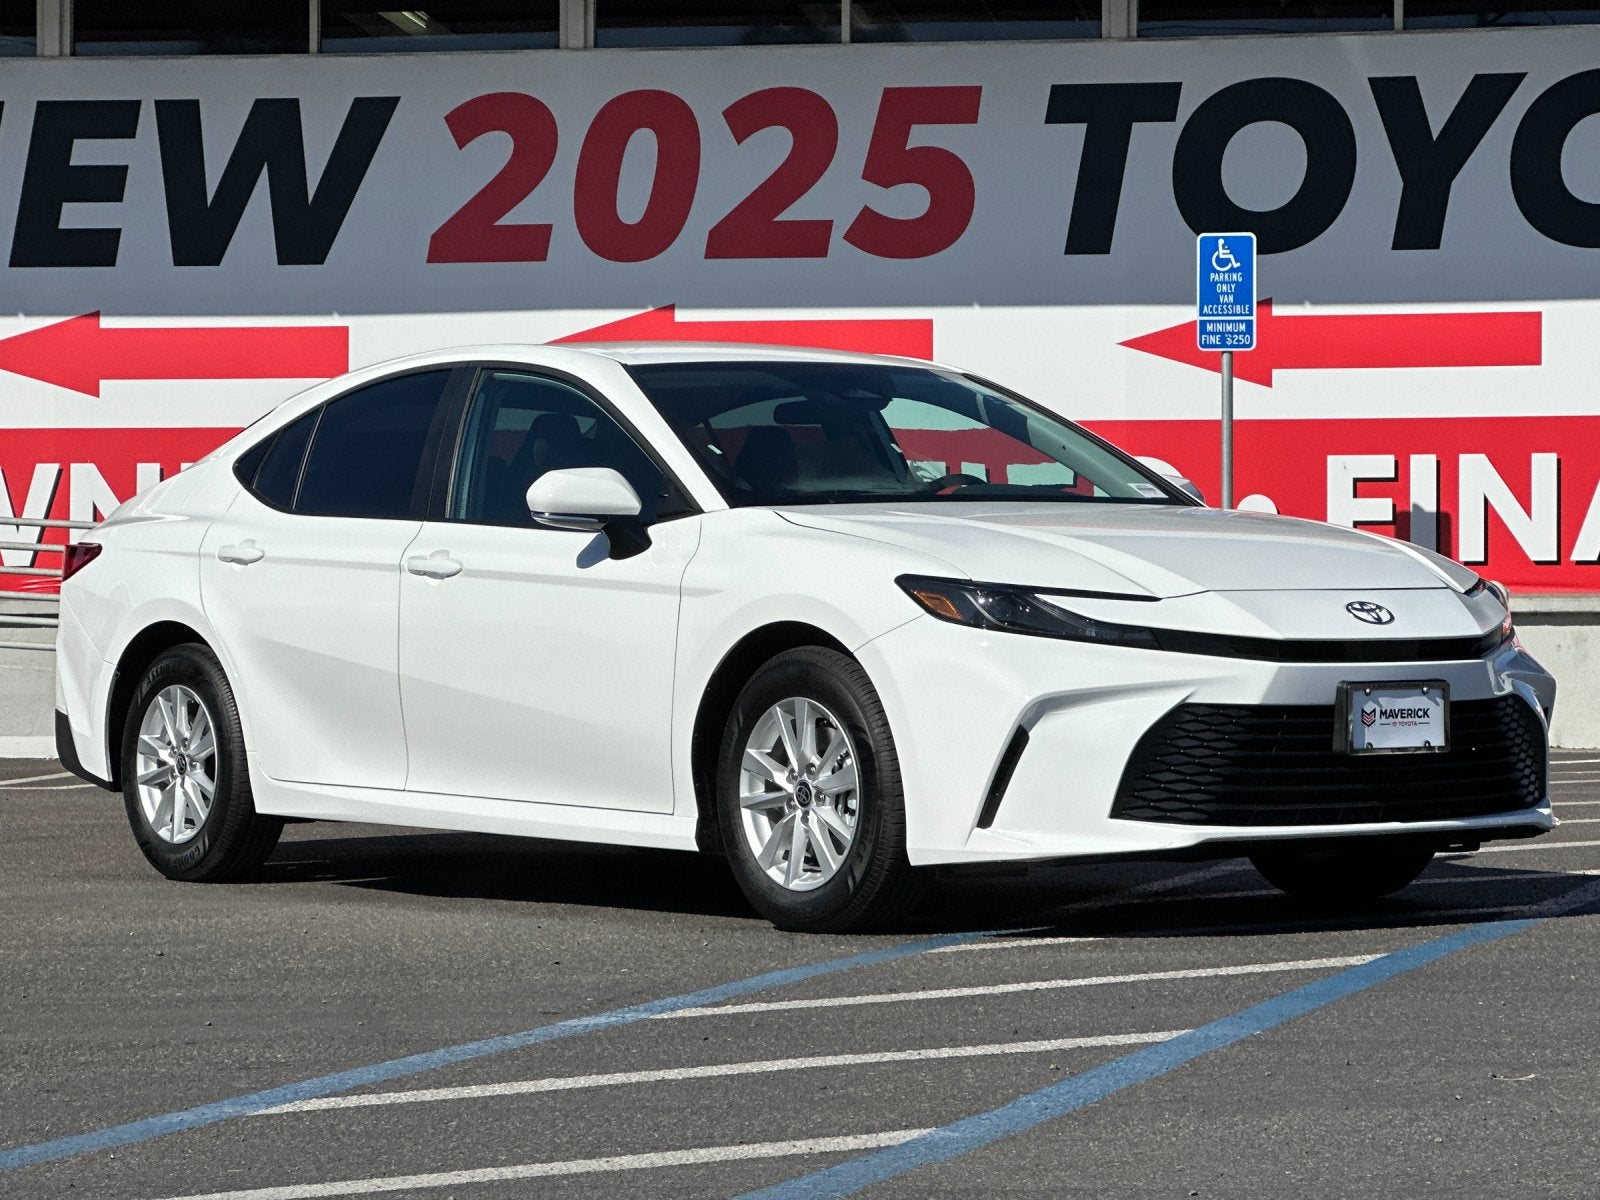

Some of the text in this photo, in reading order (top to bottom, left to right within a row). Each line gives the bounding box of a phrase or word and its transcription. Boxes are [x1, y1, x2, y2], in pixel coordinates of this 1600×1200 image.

[0, 96, 402, 268] EW
[426, 85, 983, 264] 2025
[1210, 272, 1243, 282] PARKING
[1216, 283, 1236, 293] ONLY
[1219, 294, 1234, 303] VAN
[1203, 304, 1250, 314] ACCESSIBLE
[1206, 322, 1246, 332] MINIMUM
[1201, 333, 1251, 345] FINE $250
[1326, 452, 1600, 565] FIN
[1379, 707, 1430, 719] MAVERICK
